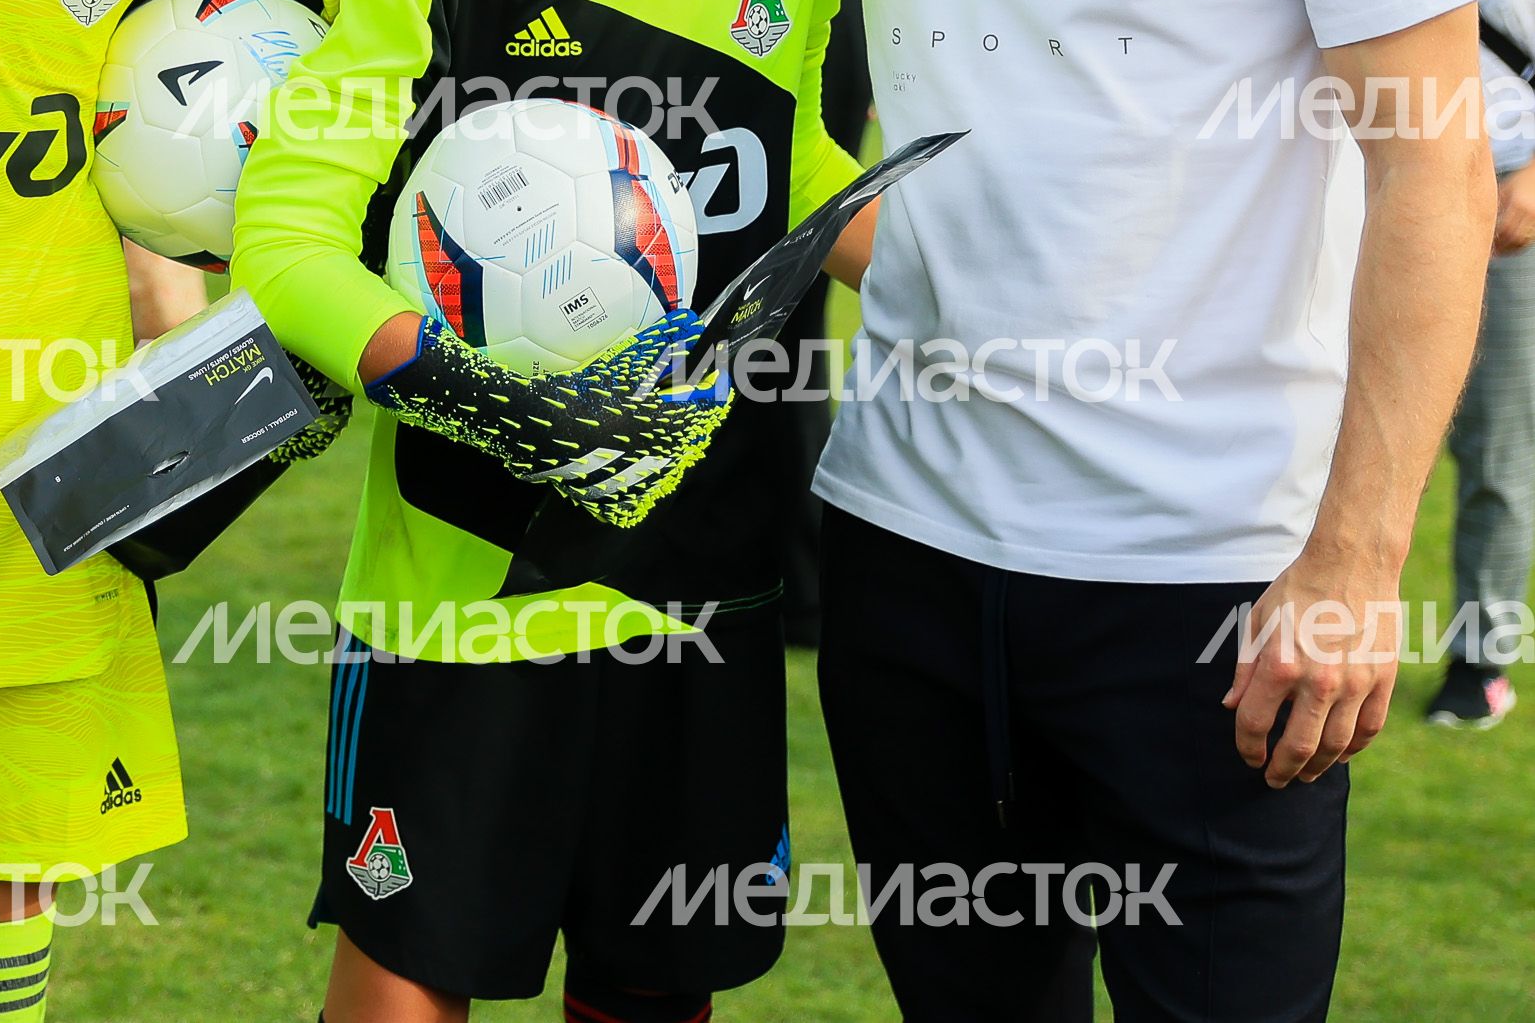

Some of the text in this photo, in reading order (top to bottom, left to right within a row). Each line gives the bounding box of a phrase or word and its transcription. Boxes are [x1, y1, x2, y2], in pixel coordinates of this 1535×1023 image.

[505, 38, 583, 57] adidas
[891, 28, 1133, 57] SPORT
[563, 294, 589, 315] IMS
[232, 337, 254, 353] GLOVES
[205, 344, 262, 386] MATCH
[210, 353, 229, 367] GANTS
[188, 368, 205, 380] LUVAS
[269, 408, 298, 429] FOOTBALL
[242, 427, 265, 444] SOCCER
